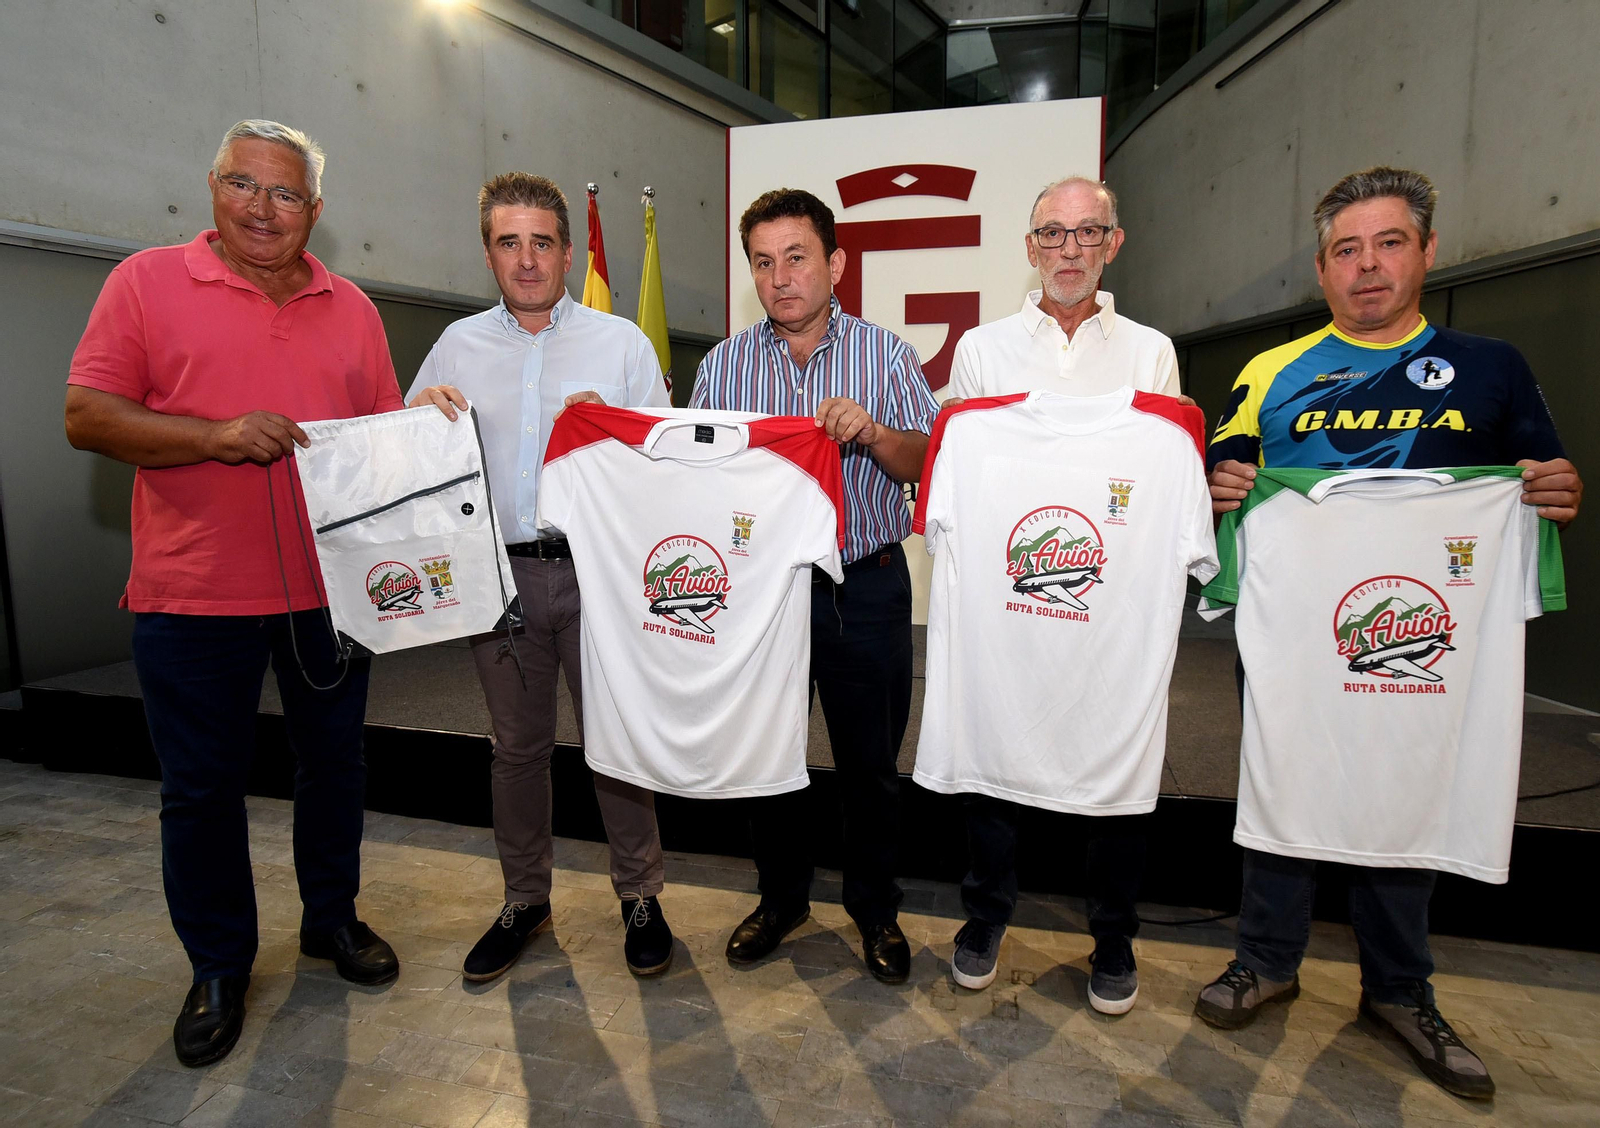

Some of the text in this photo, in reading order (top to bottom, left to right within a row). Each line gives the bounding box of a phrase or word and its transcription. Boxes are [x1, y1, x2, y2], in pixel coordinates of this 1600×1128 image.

[1028, 510, 1069, 526] EDICIÓN
[661, 539, 698, 553] EDICIÓN
[1031, 538, 1108, 574] Avión
[381, 574, 422, 599] Avión
[665, 565, 732, 597] Avión
[1353, 579, 1402, 600] EDICIÓN
[377, 609, 425, 622] RUTA SOLIDARIA
[1006, 601, 1090, 622] RUTA SOLIDARIA
[642, 621, 716, 645] RUTA SOLIDARIA
[1364, 606, 1458, 649] Avión
[1343, 682, 1447, 694] RUTA SOLIDARIA
